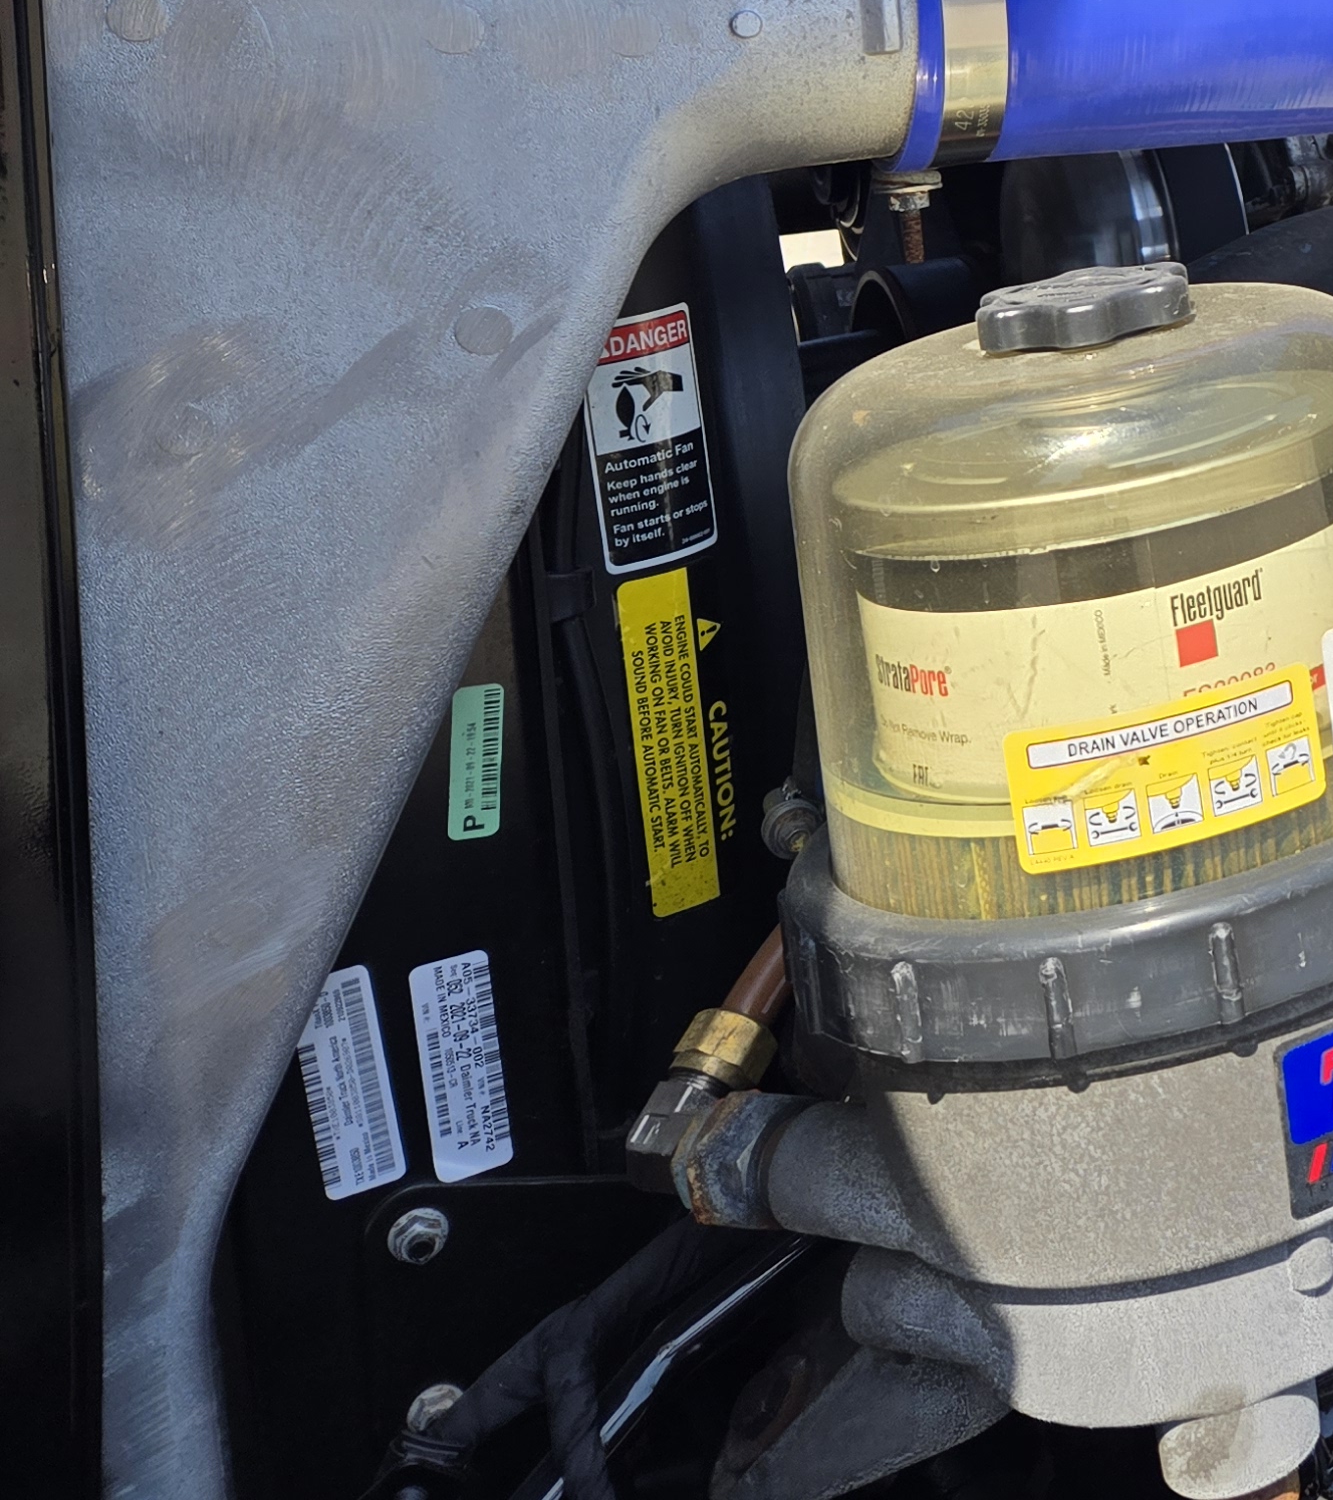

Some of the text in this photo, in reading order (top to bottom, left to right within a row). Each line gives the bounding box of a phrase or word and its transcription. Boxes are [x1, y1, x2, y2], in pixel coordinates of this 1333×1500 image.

[609, 319, 687, 357] DANGER
[604, 441, 694, 474] Automatic Fan
[607, 460, 698, 492] Keep hands clear
[608, 476, 690, 504] when engine is
[610, 500, 659, 518] running.
[613, 500, 708, 536] Fan starts or stops
[614, 528, 665, 548] by itself.
[1169, 569, 1263, 627] Fleetguard
[875, 654, 949, 698] StrataPore
[645, 623, 683, 869] WORKING ON FAN OR BELTS. ALARM WILL
[660, 620, 698, 864] AVOID INJURY, TURN IGNITION OFF WHEN
[675, 614, 710, 858] ENGINE COULD START AUTOMATICALLY, TO
[902, 725, 972, 746] Remove Wrap.
[1067, 738, 1116, 757] DRAIN
[1119, 724, 1169, 747] VALVE
[1173, 698, 1259, 733] OPERATION
[631, 650, 666, 853] SOUND BEFORE AUTOMATIC START.
[709, 699, 737, 841] CAUTION:
[463, 814, 485, 832] P
[329, 1035, 341, 1062] America
[433, 965, 469, 1150] MADE IN MEXICO A
[338, 1082, 349, 1100] Truck
[450, 1000, 481, 1146] 2021-09-22 Daimler Truck NA
[342, 1100, 354, 1126] Daimler
[480, 1104, 496, 1152] NA2742
